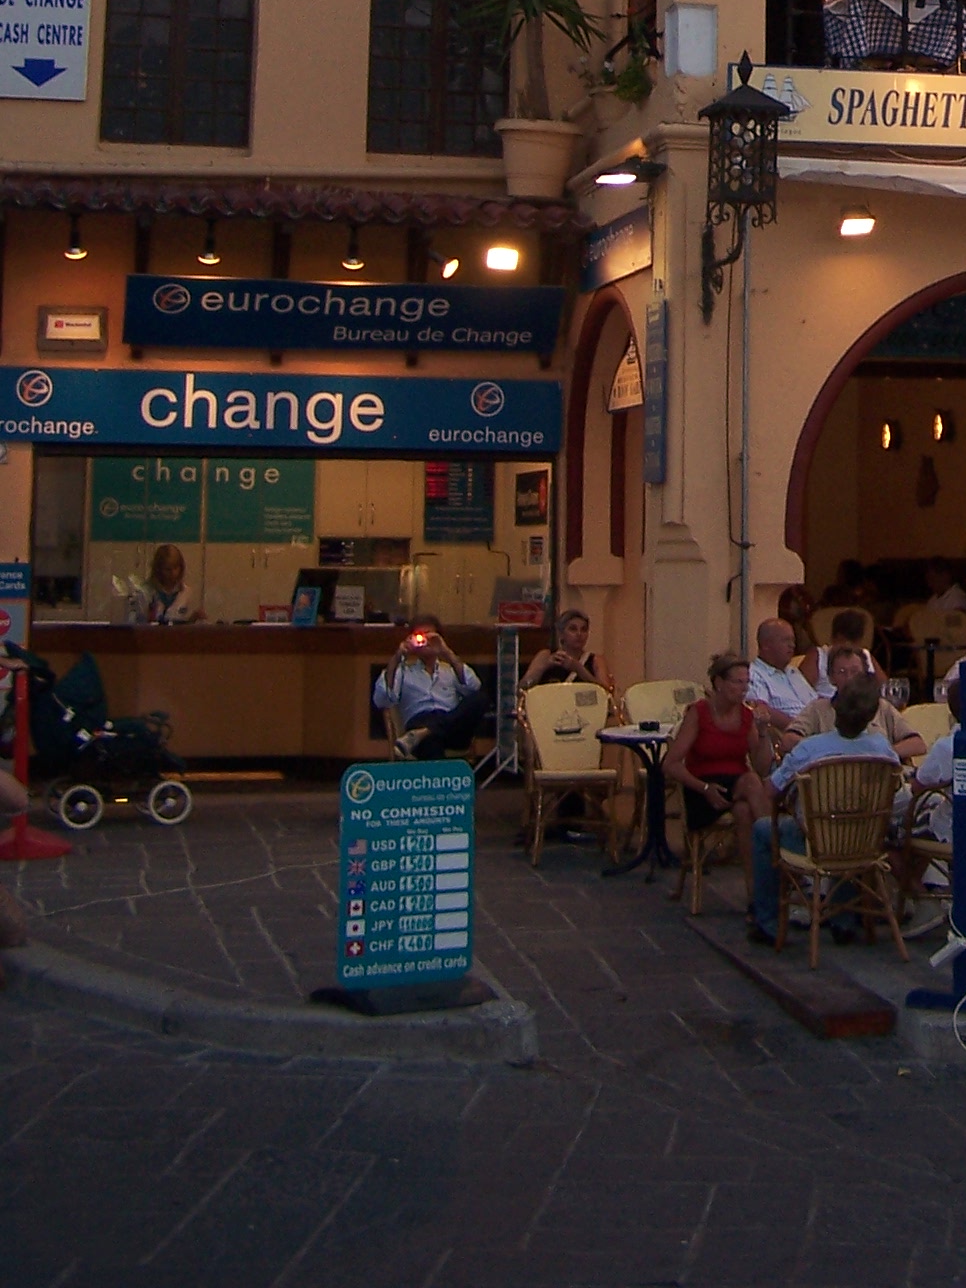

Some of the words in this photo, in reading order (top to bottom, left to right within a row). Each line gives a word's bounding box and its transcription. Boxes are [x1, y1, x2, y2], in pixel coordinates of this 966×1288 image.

[37, 23, 83, 47] CENTRE
[201, 288, 451, 323] eurochange
[332, 325, 410, 344] Bureau
[417, 327, 446, 344] de
[451, 327, 533, 347] Change
[140, 373, 386, 444] change
[428, 424, 545, 447] eurochange
[131, 457, 281, 491] change
[375, 775, 472, 792] eurochange
[350, 809, 373, 821] NO
[380, 804, 466, 819] COMMISION
[365, 819, 382, 829] FOR
[370, 840, 397, 852] USD
[370, 860, 397, 873] GBP
[370, 880, 397, 893] AUD
[370, 900, 396, 912] CAD
[370, 919, 395, 932] JPY
[369, 939, 395, 952] CHF
[342, 964, 365, 978] Cash
[365, 961, 402, 976] advance
[403, 960, 416, 973] on
[417, 956, 442, 971] credit
[443, 953, 468, 968] cards
